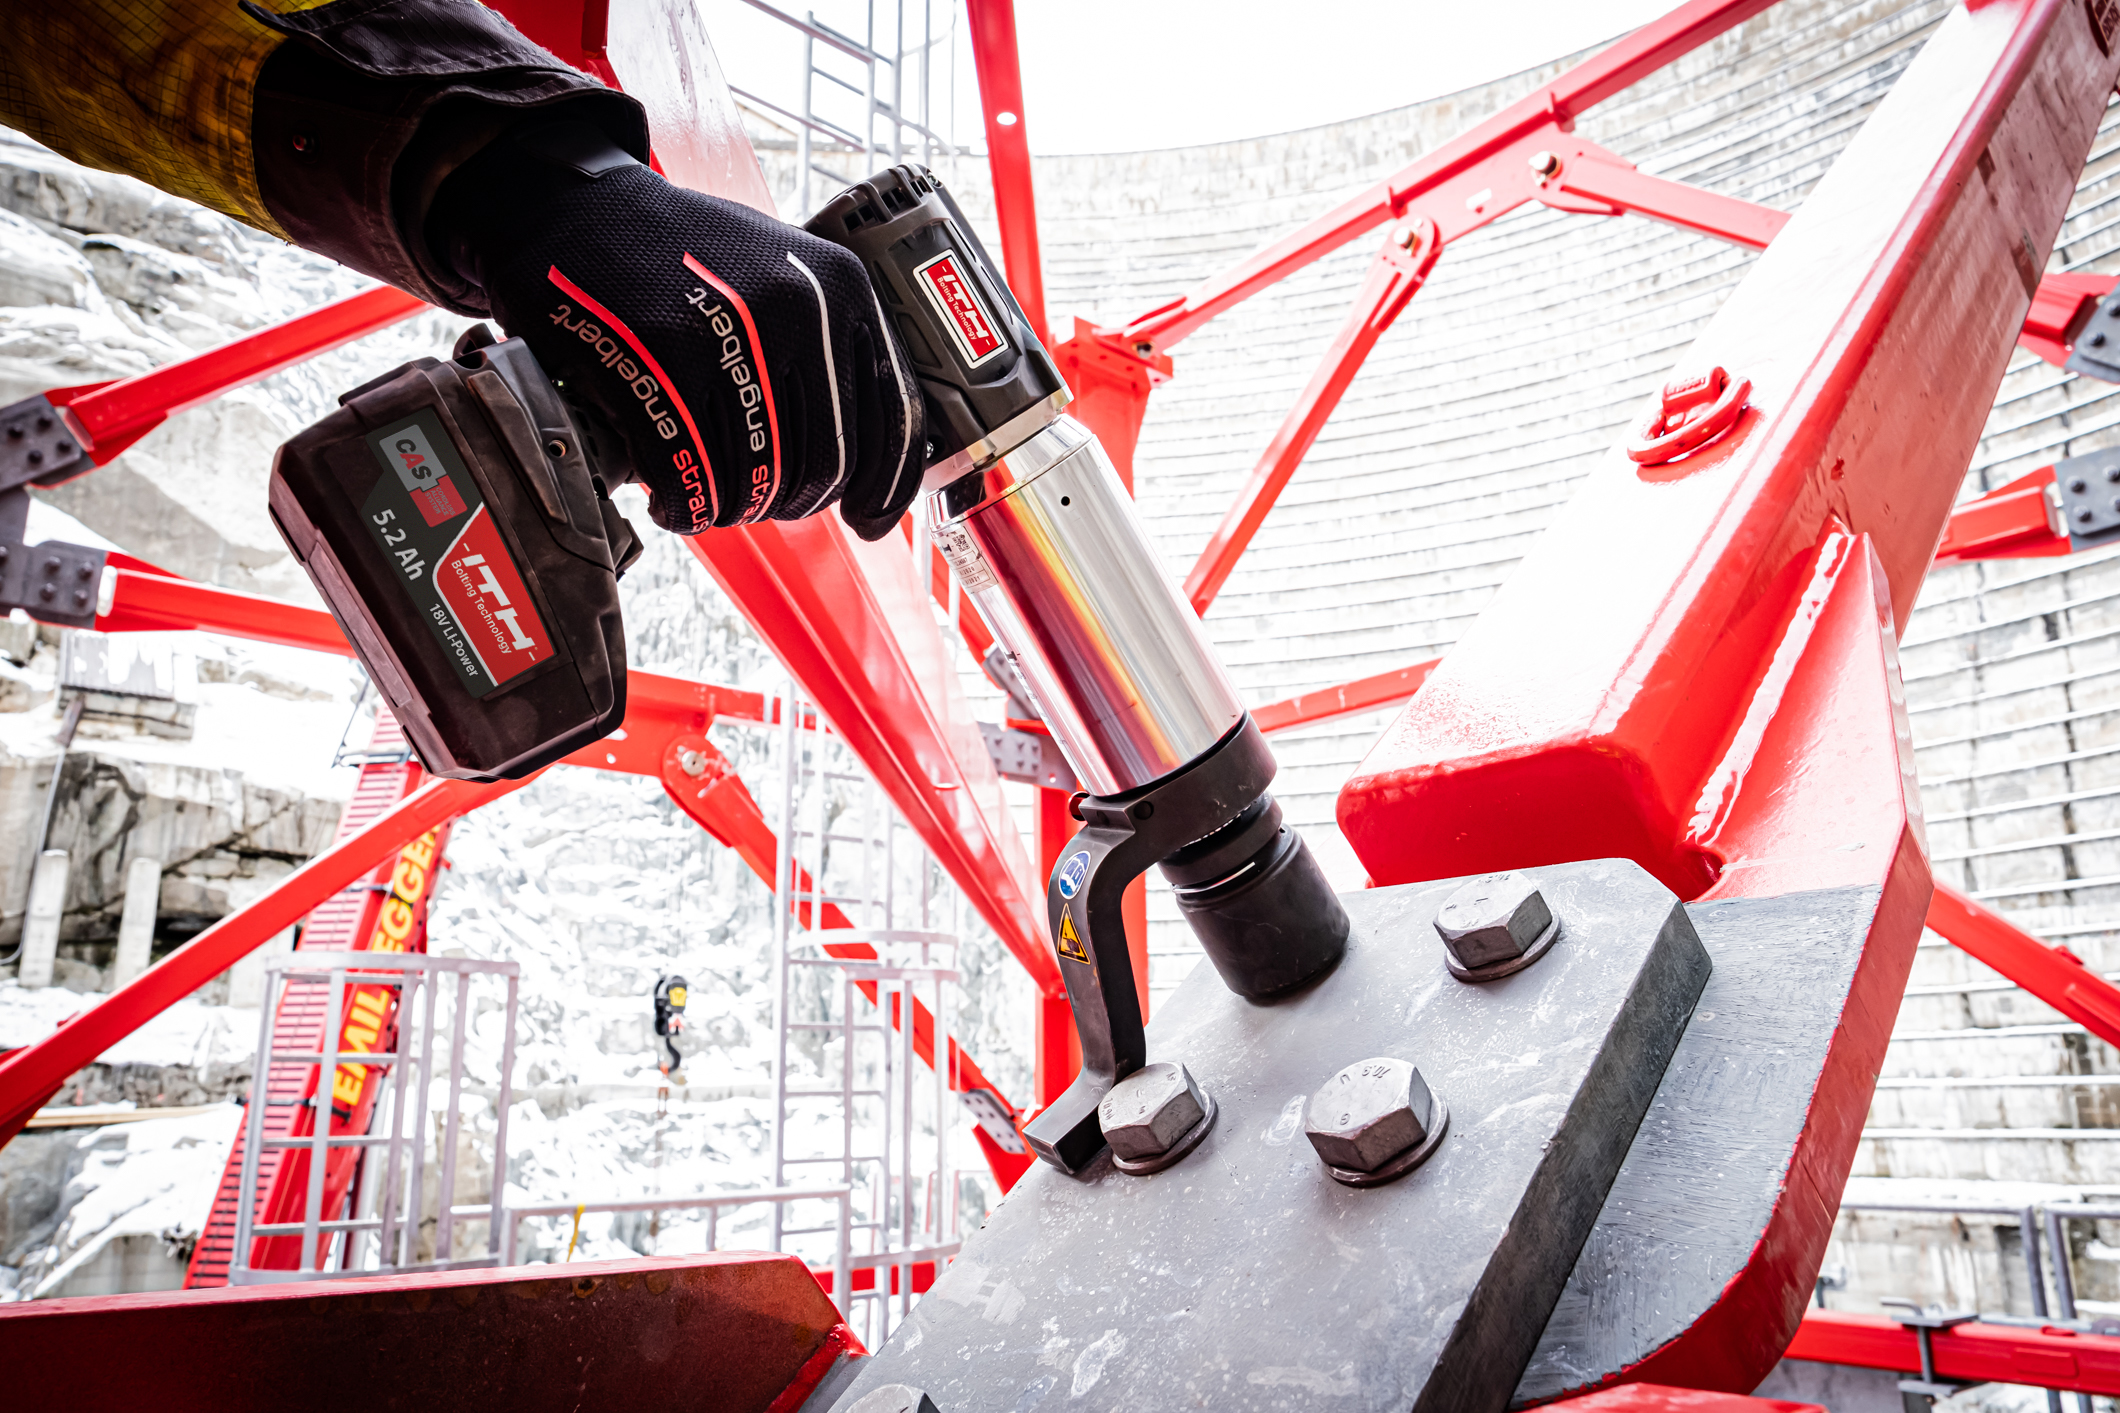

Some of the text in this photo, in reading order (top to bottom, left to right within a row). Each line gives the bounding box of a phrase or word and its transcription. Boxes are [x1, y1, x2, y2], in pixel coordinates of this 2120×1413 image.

[937, 277, 977, 340] Bolting Technology
[549, 304, 678, 440] engelbert
[684, 287, 767, 452] engelbert
[424, 491, 441, 515] SYSTEM
[436, 486, 456, 516] CORDLESS
[372, 508, 426, 581] 5.2 Ah
[429, 603, 451, 634] 18V
[451, 560, 512, 655] Bolting Technology
[332, 989, 389, 1106] EMIL
